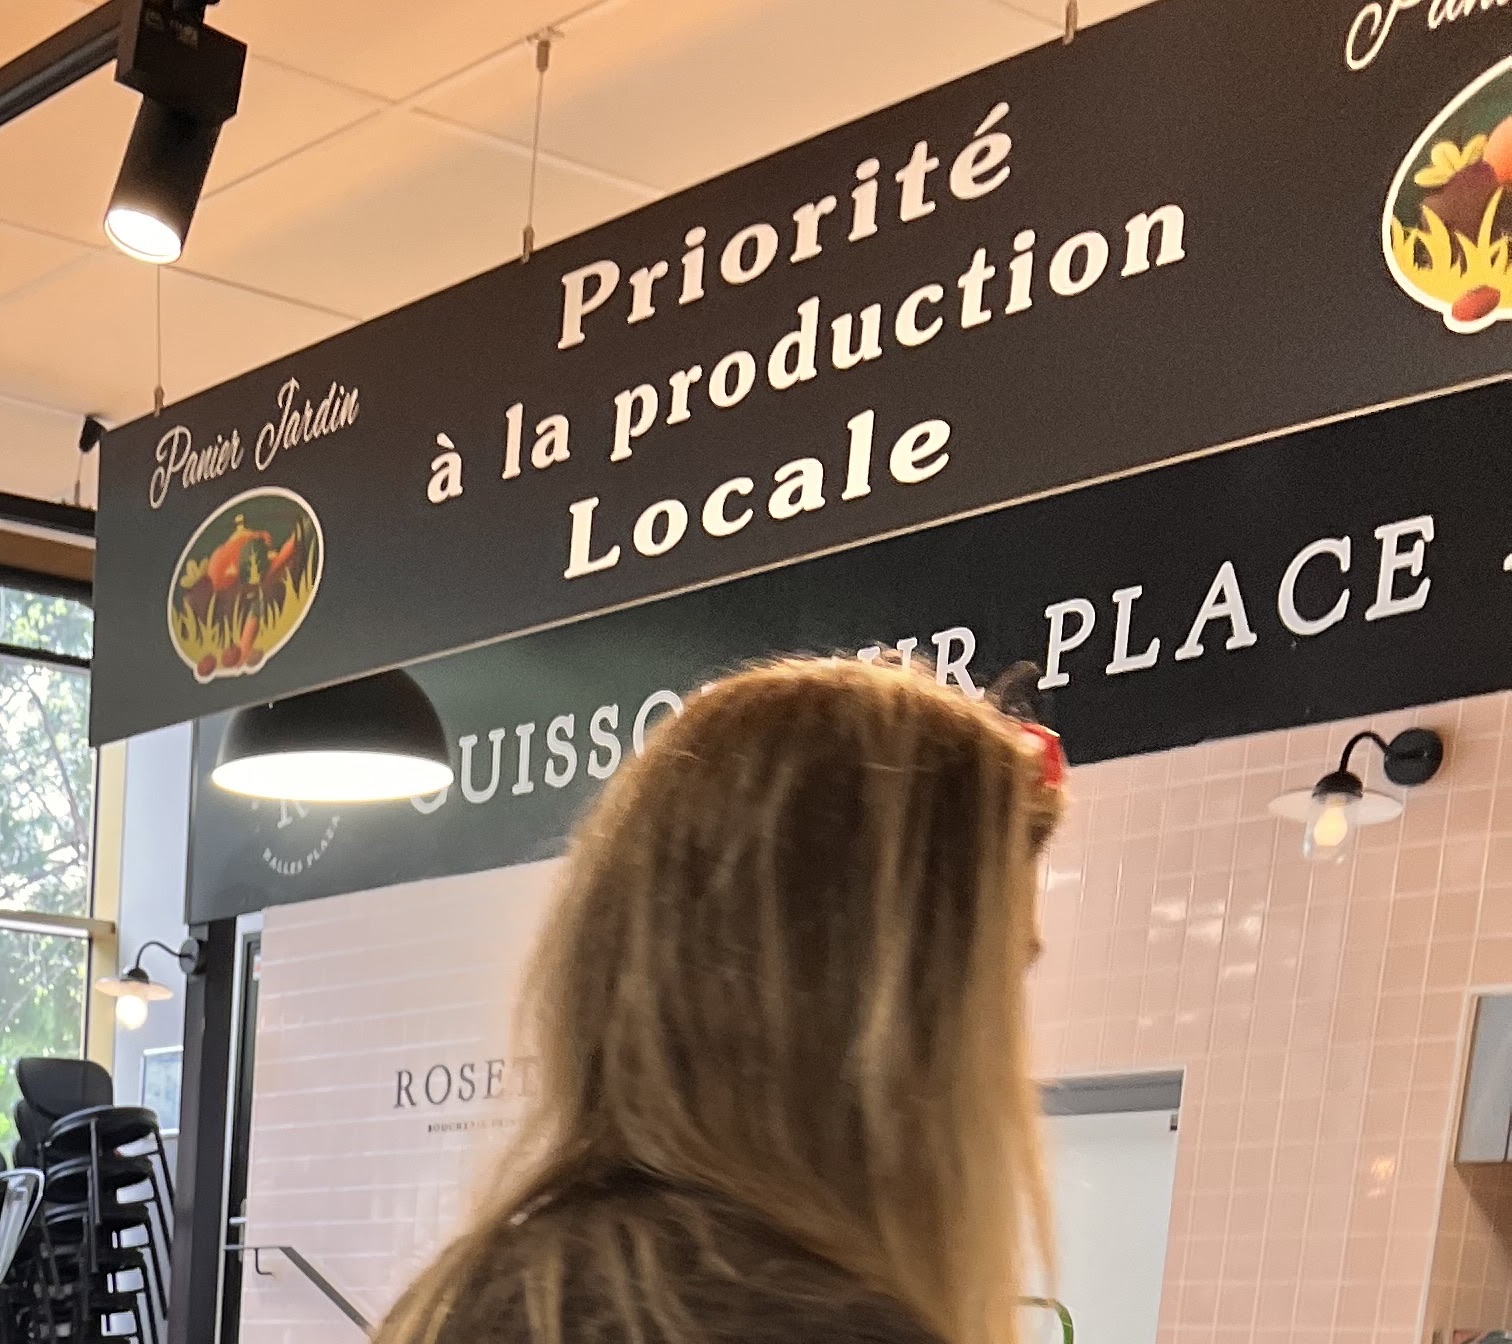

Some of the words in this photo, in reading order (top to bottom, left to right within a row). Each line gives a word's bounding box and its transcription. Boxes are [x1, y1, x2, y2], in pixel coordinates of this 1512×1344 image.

[556, 101, 1014, 350] Priorité
[426, 431, 465, 505] à
[500, 401, 572, 480] la
[609, 201, 1189, 463] production
[149, 425, 245, 510] Panier
[254, 376, 361, 471] Jardin
[562, 408, 953, 581] Locale
[1036, 514, 1436, 692] PLACE
[409, 686, 719, 815] UISSO
[393, 1054, 540, 1110] ROSET
